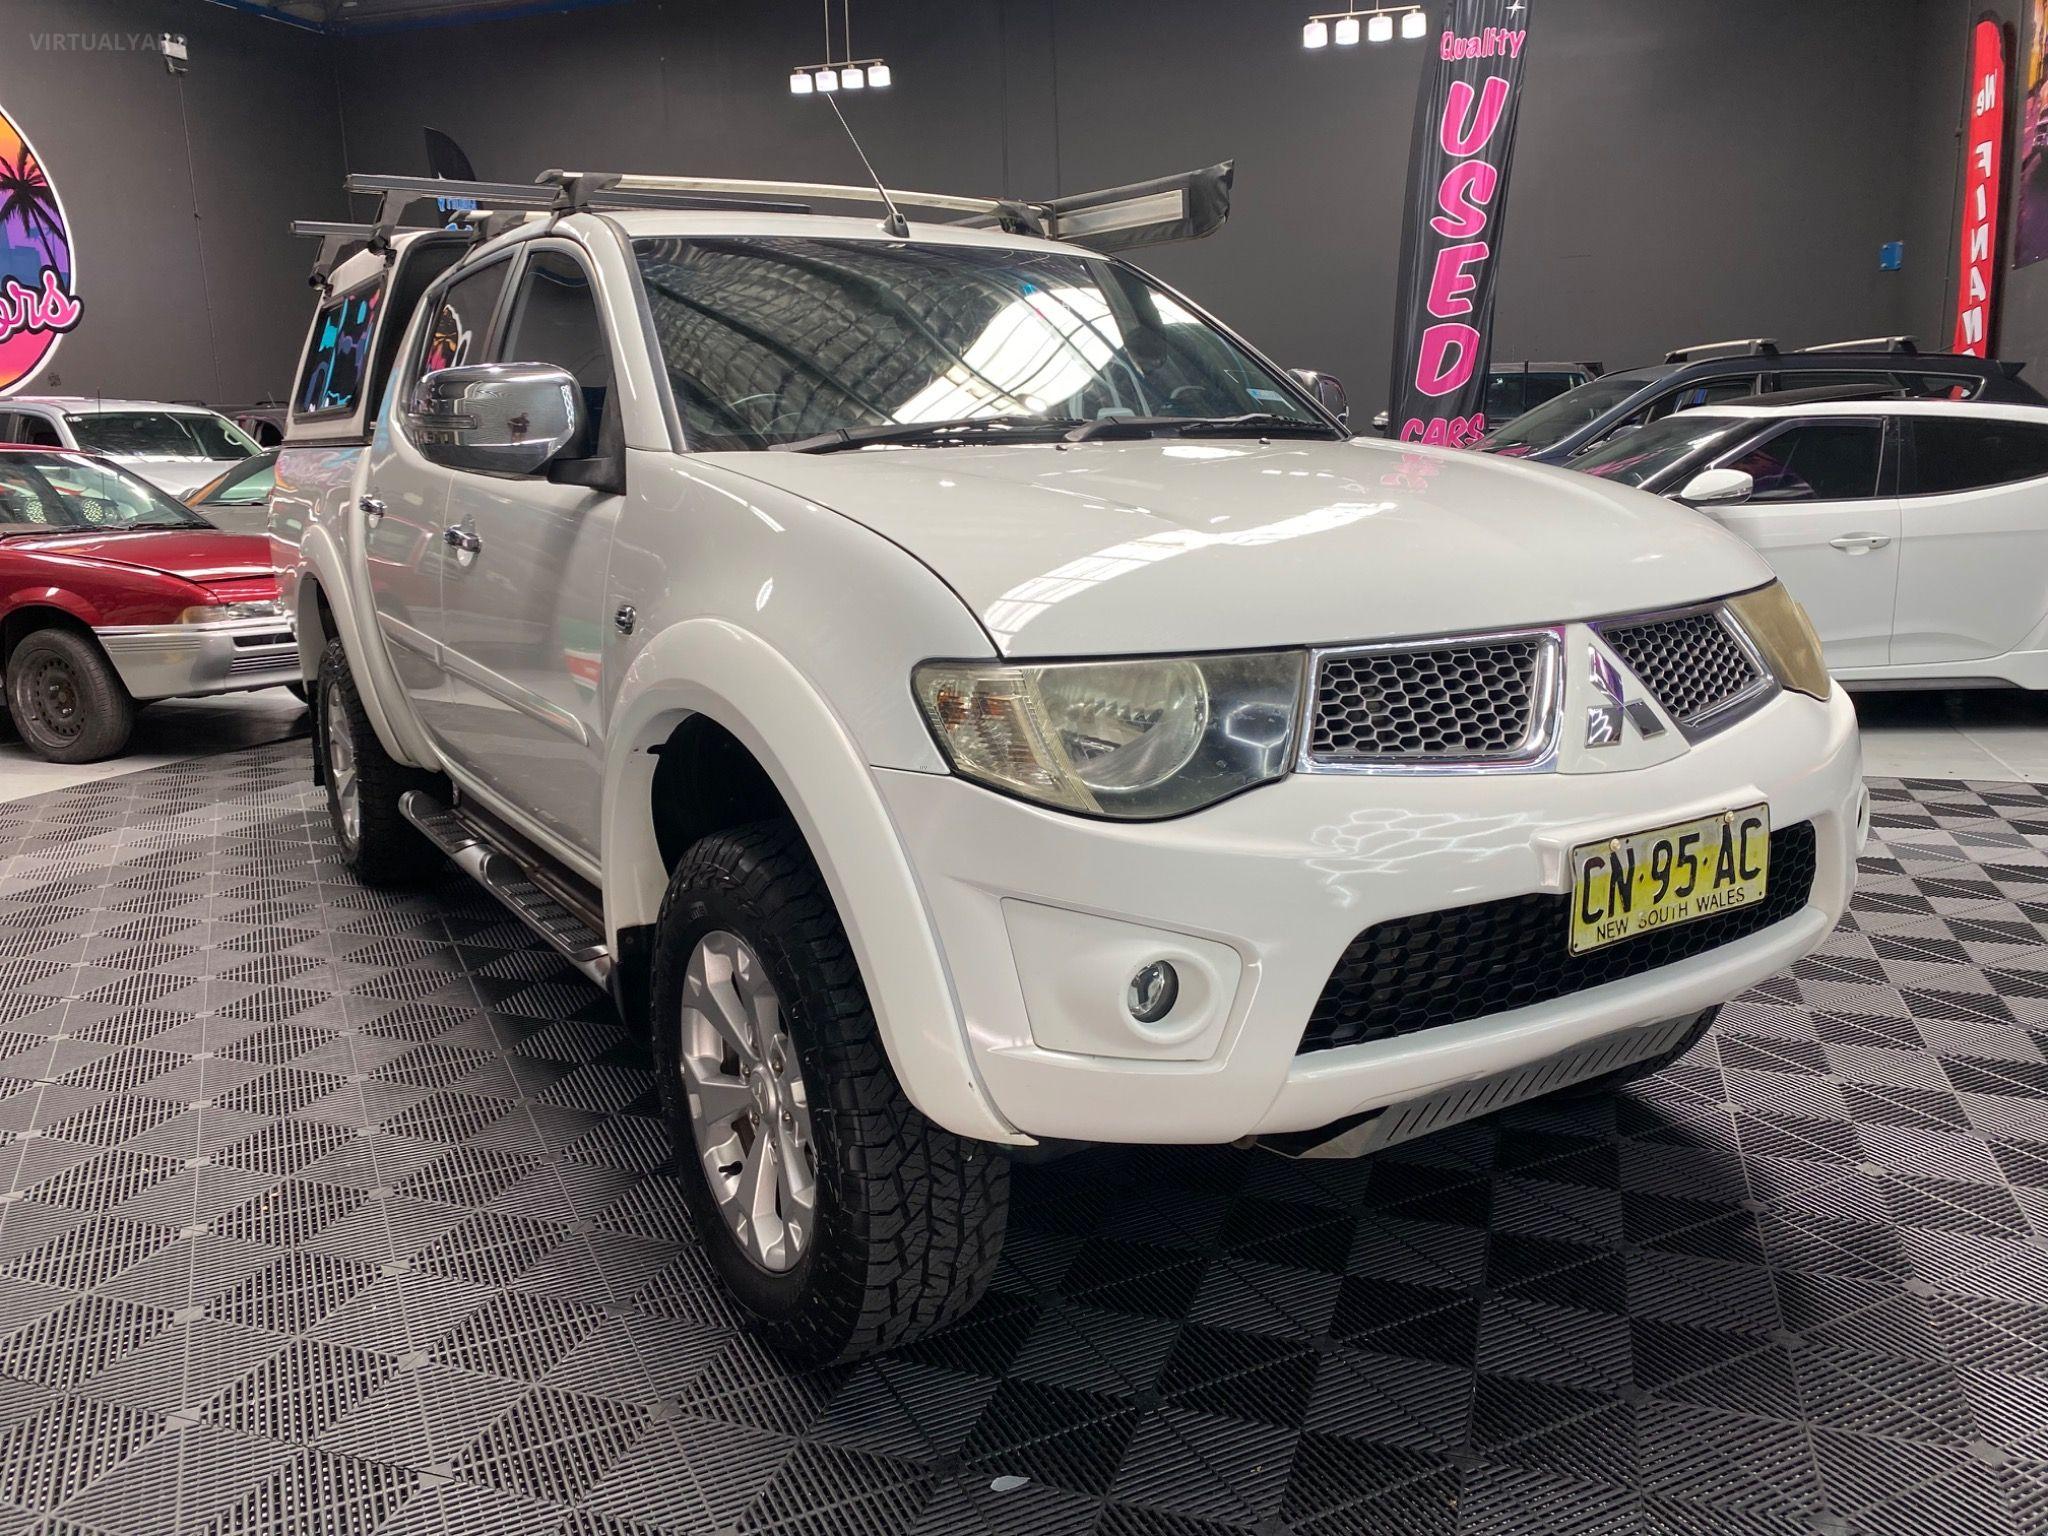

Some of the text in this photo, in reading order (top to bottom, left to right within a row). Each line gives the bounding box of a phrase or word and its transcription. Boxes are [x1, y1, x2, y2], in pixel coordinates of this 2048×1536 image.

[1440, 27, 1526, 61] Quality
[1415, 76, 1510, 397] USED
[1400, 412, 1485, 450] CARS
[1597, 887, 1746, 942] NEW SOUTH WALES
